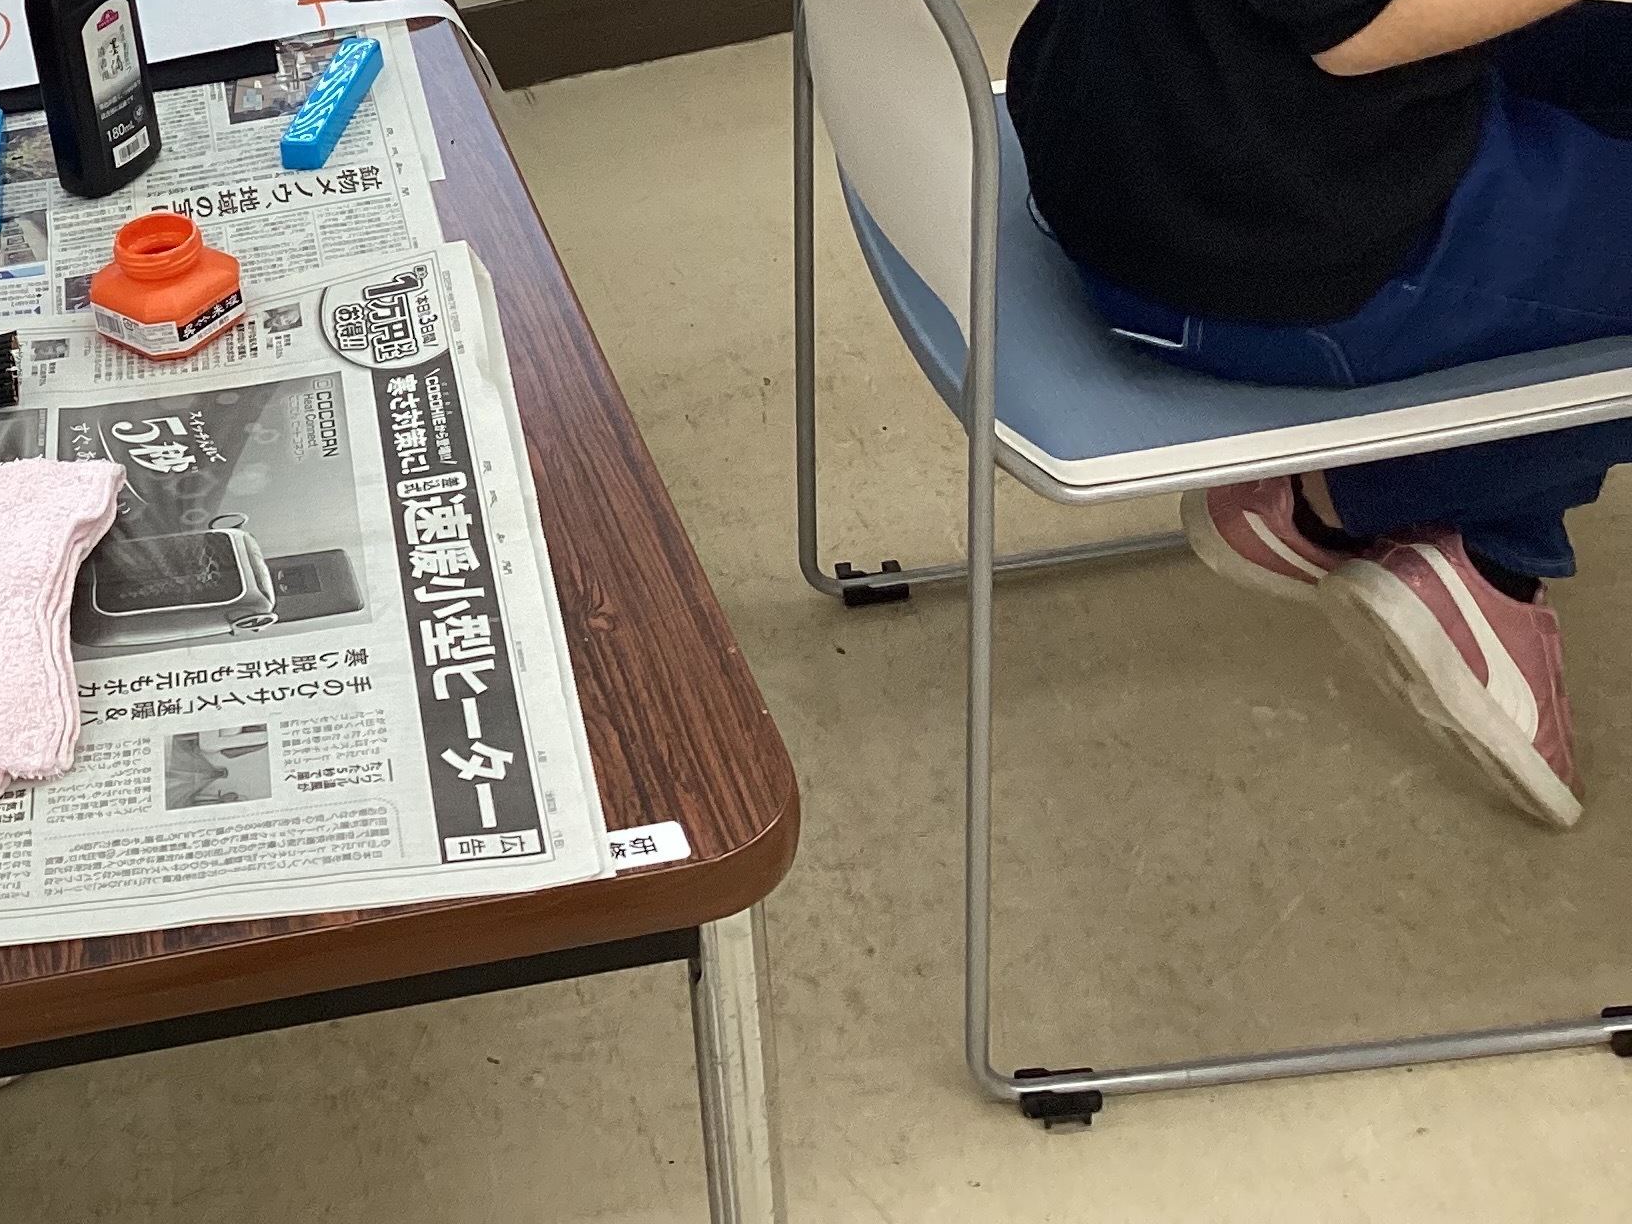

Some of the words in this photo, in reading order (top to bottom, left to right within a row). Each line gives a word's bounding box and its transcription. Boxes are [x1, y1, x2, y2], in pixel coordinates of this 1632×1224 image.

[304, 393, 315, 418] Heat
[306, 419, 317, 449] Connect
[316, 389, 339, 458] COCODAN
[386, 373, 427, 475] 寒さ対策に!
[400, 492, 515, 829] 速暖小型ヒーター
[458, 836, 527, 858] 広告
[610, 834, 658, 863] 研修
